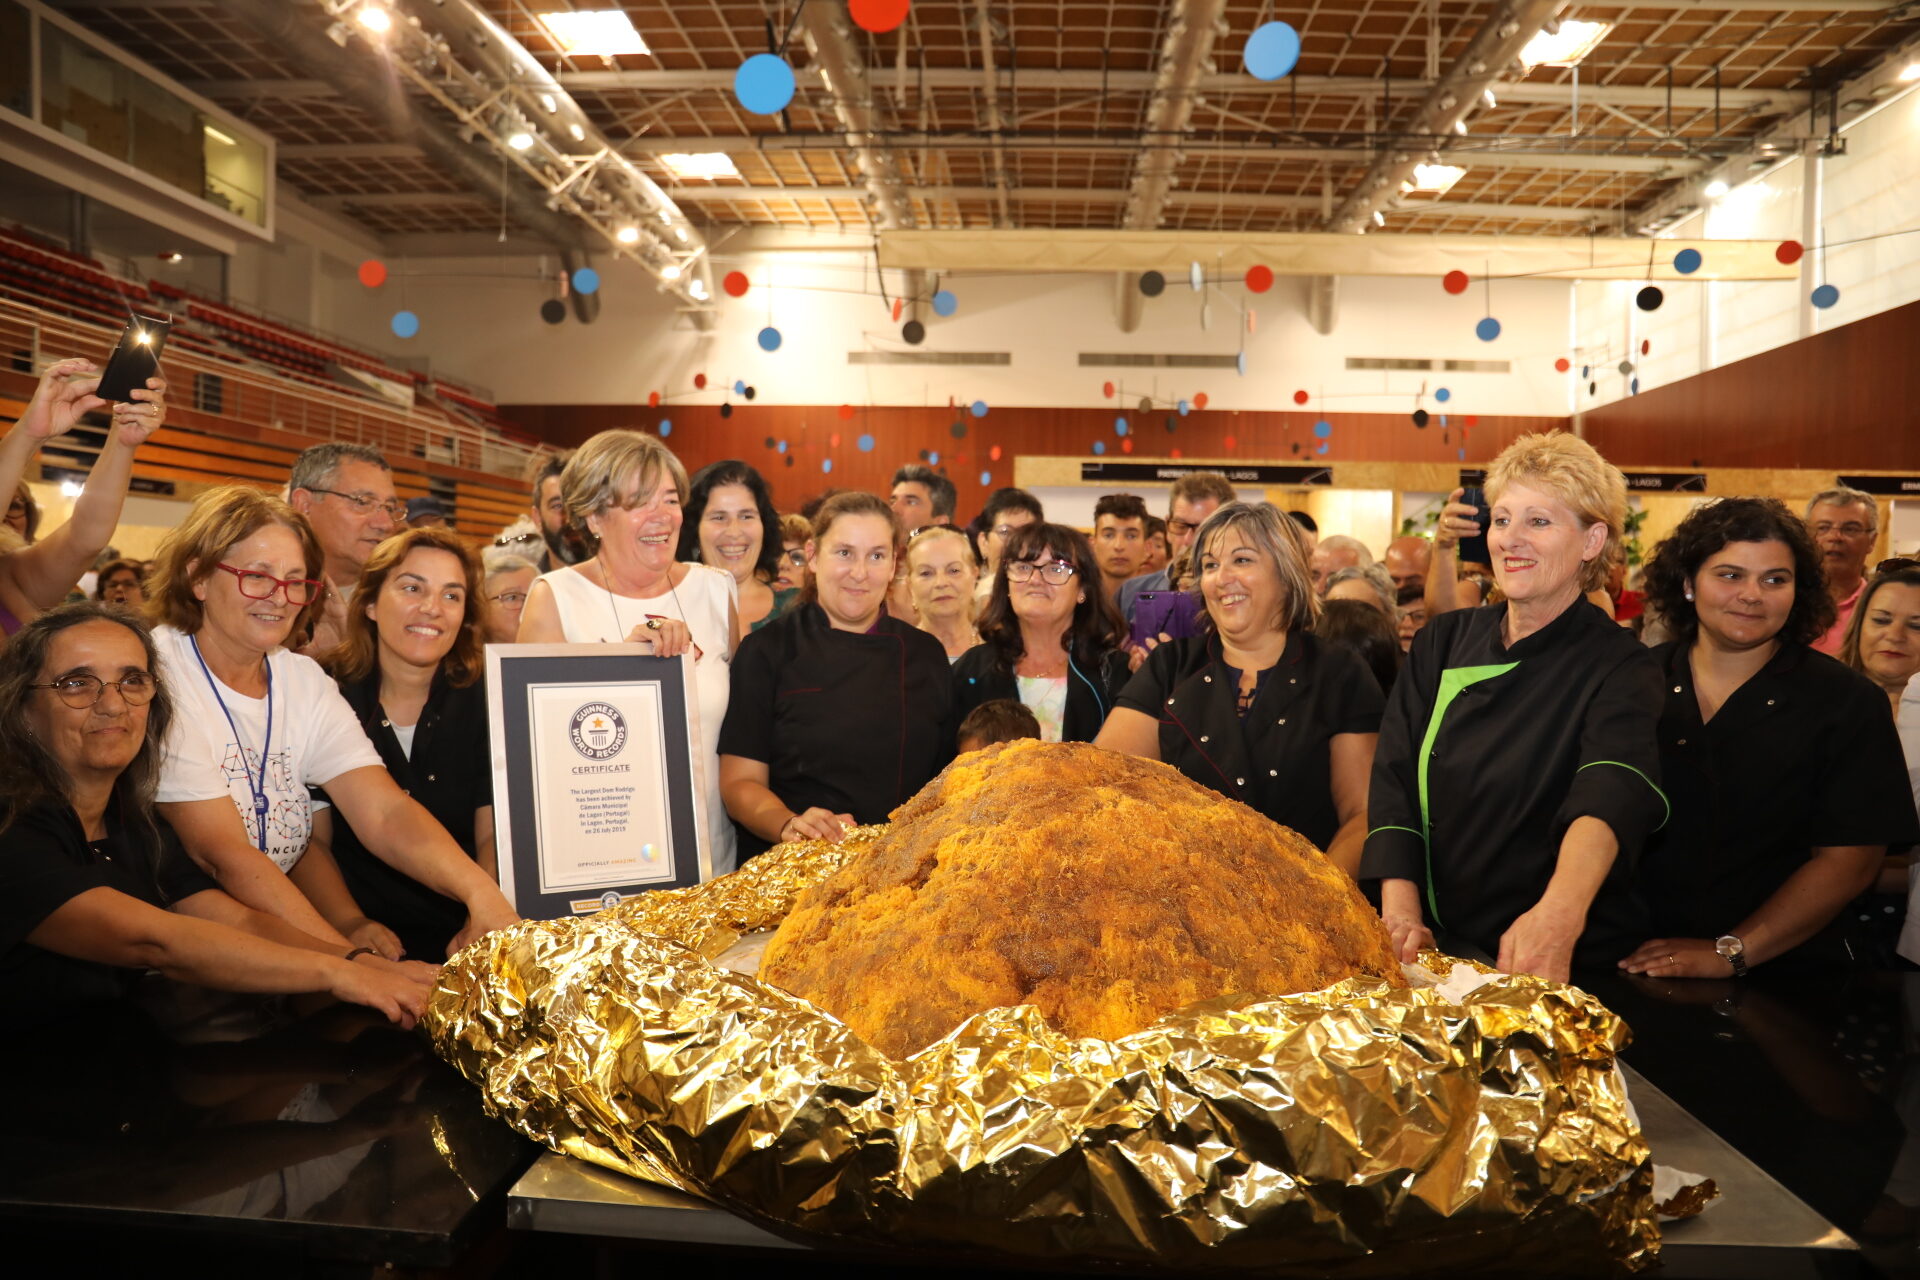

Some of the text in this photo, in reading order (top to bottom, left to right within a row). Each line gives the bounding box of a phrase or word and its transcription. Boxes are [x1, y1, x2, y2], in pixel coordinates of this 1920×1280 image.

[575, 704, 619, 722] GUINNESS
[571, 726, 626, 759] WORLD RECORDS
[571, 763, 631, 775] CERTIFICATE
[586, 811, 602, 819] Lagos
